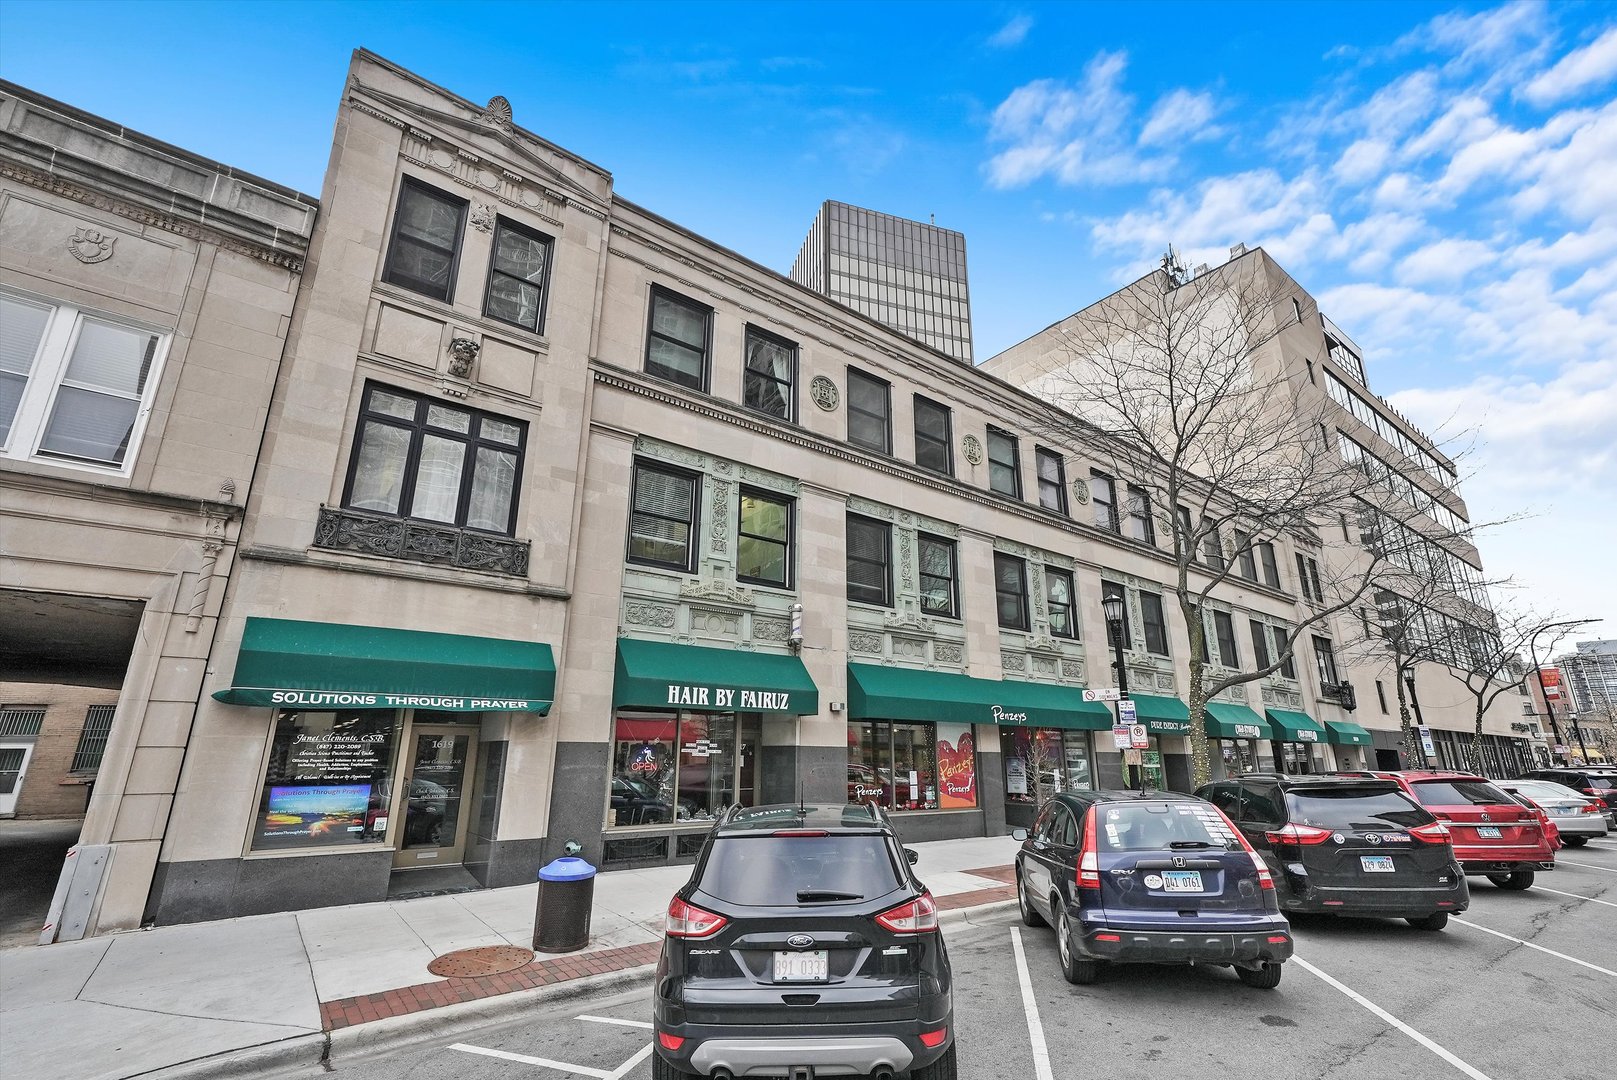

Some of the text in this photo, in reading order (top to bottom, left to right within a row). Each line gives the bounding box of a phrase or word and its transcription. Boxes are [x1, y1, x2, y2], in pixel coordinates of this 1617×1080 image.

[271, 691, 528, 709] SOLUTIONS THROUGH PRAYER
[667, 685, 789, 710] HAIR BY FAIRUZ
[991, 705, 1027, 724] Penzeys
[293, 734, 320, 745] Janet
[432, 740, 454, 749] 1619
[631, 762, 657, 771] OPEN
[854, 784, 884, 798] Penzeys
